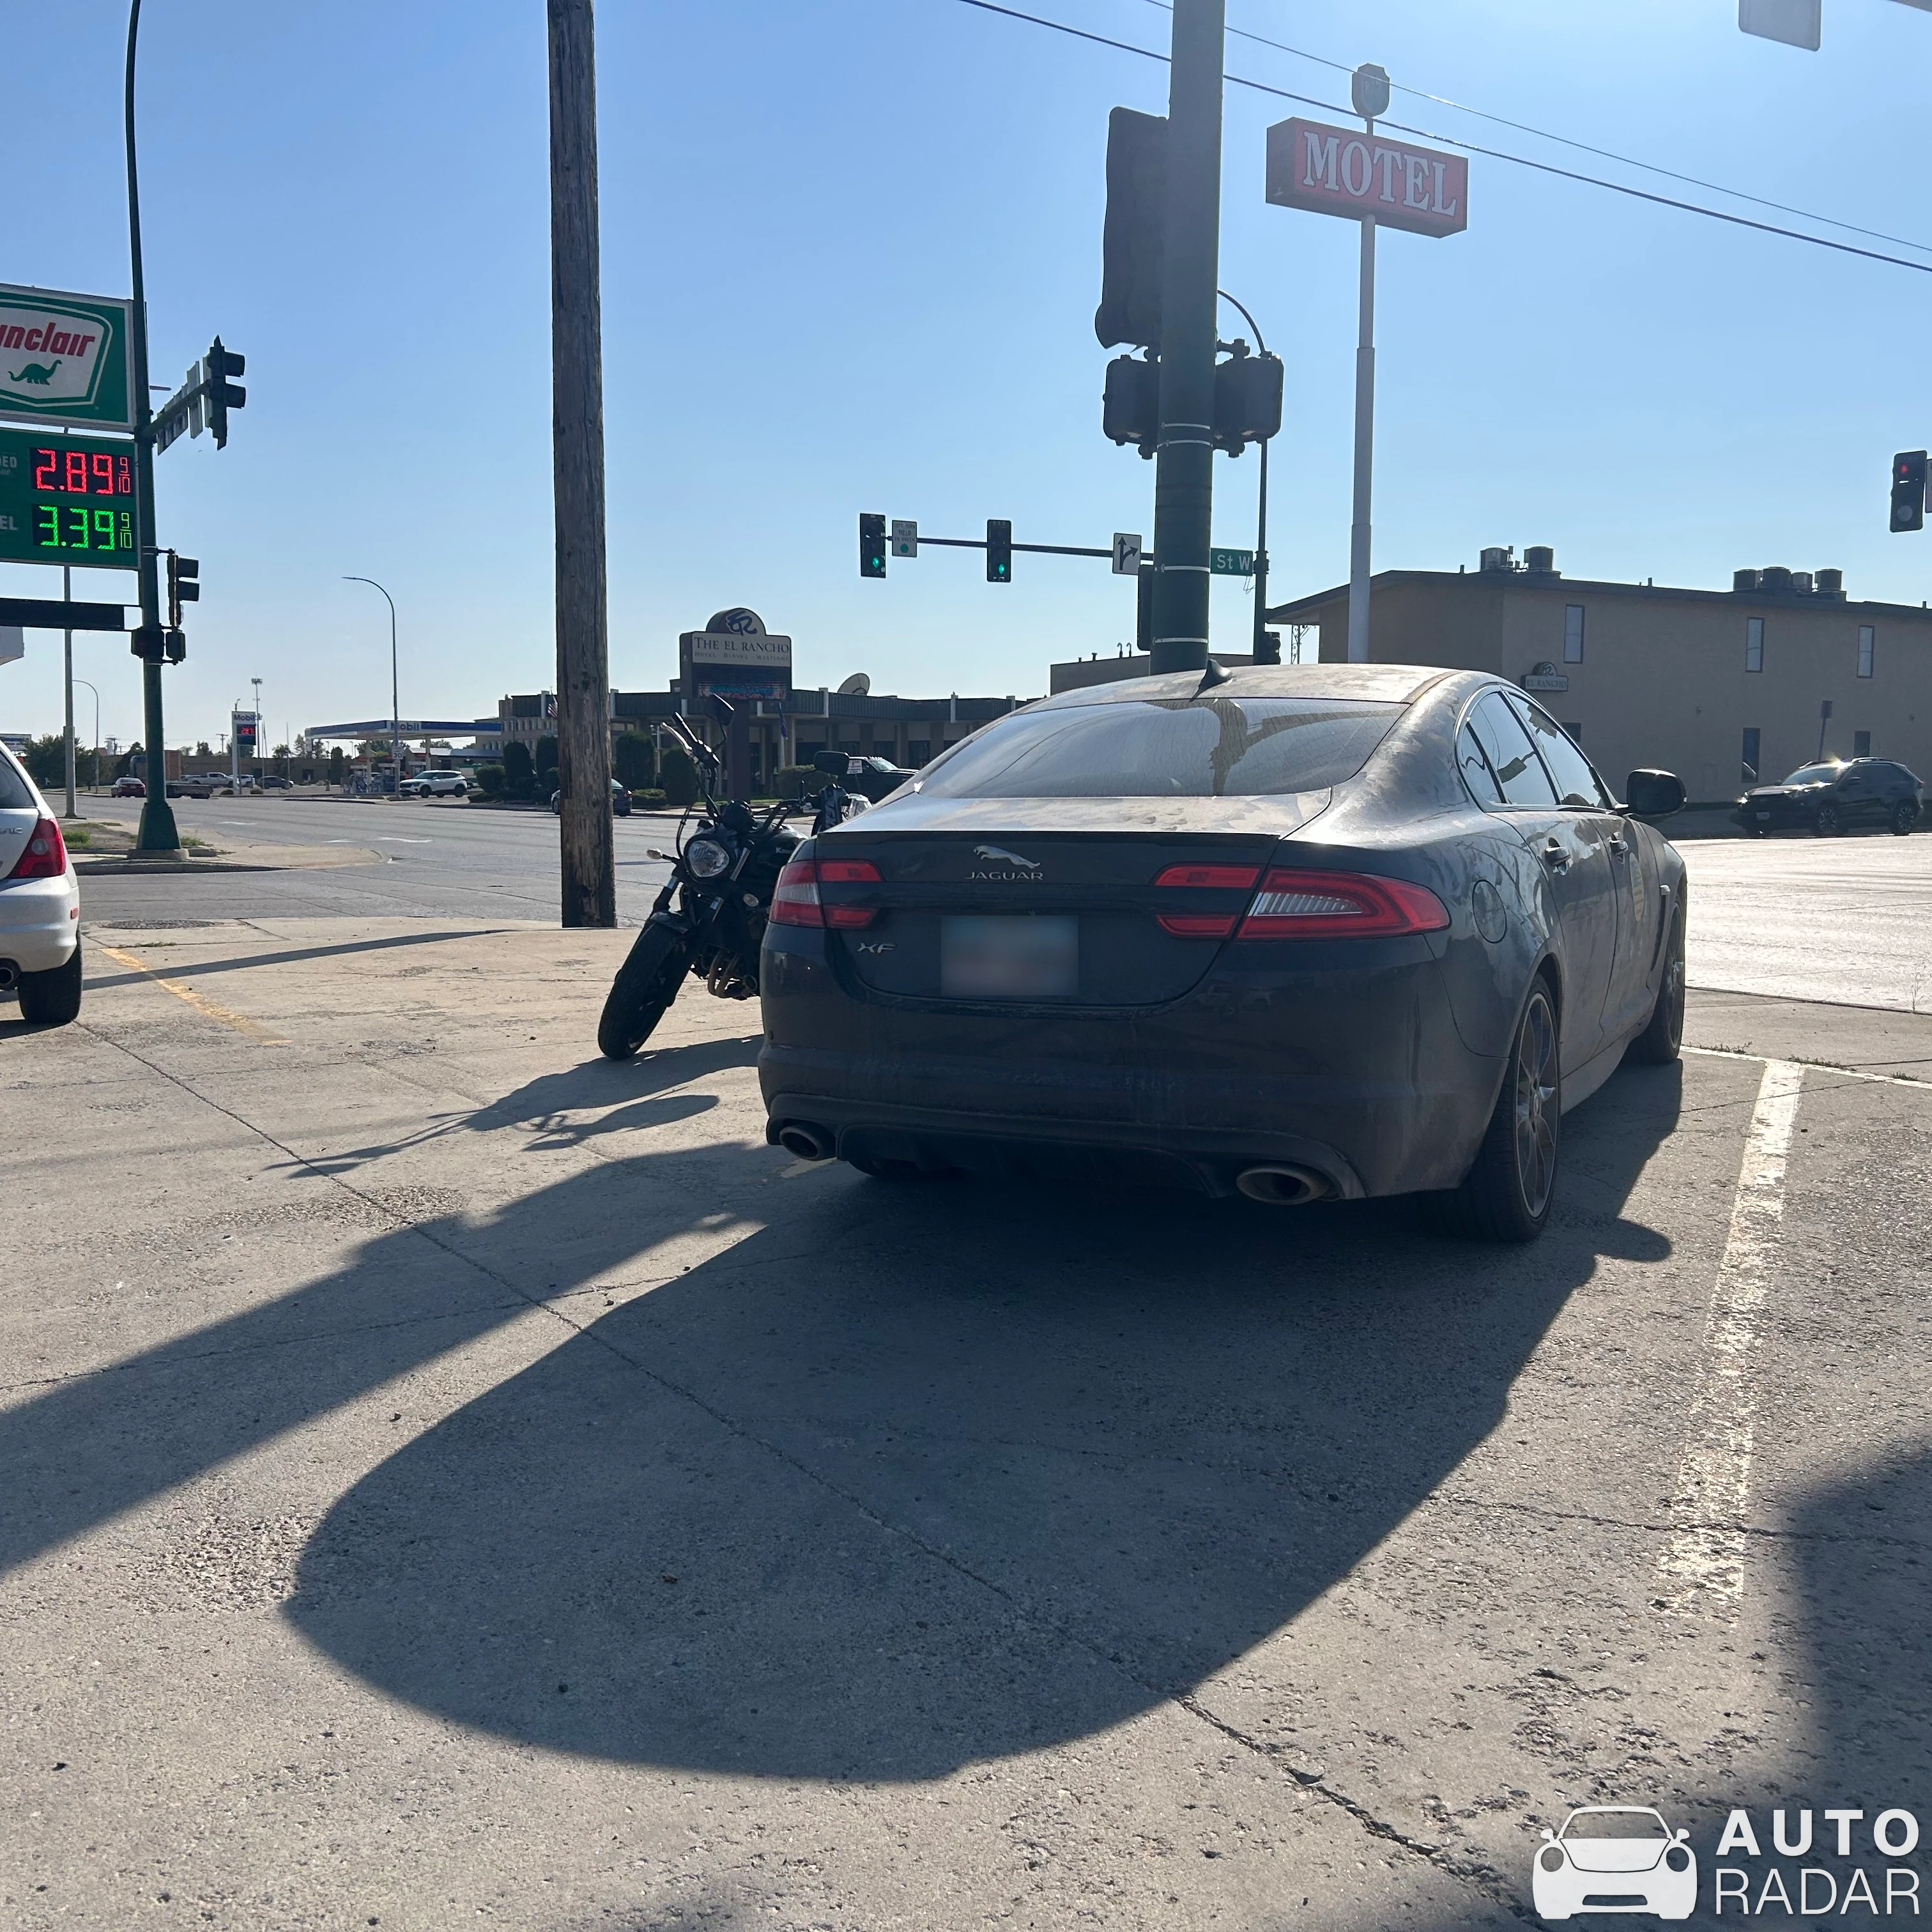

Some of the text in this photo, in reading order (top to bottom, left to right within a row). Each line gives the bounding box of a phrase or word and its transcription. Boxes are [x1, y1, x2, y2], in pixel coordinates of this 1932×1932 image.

[1302, 131, 1457, 217] MOTEL
[0, 455, 17, 468] ED
[36, 448, 113, 494] 2.89
[39, 505, 115, 551] 3.39
[1216, 554, 1250, 570] St W
[694, 637, 789, 654] THE EL RANCHO
[1537, 679, 1567, 688] RANCHO
[965, 871, 1043, 880] JAGUAR
[857, 942, 896, 953] XF
